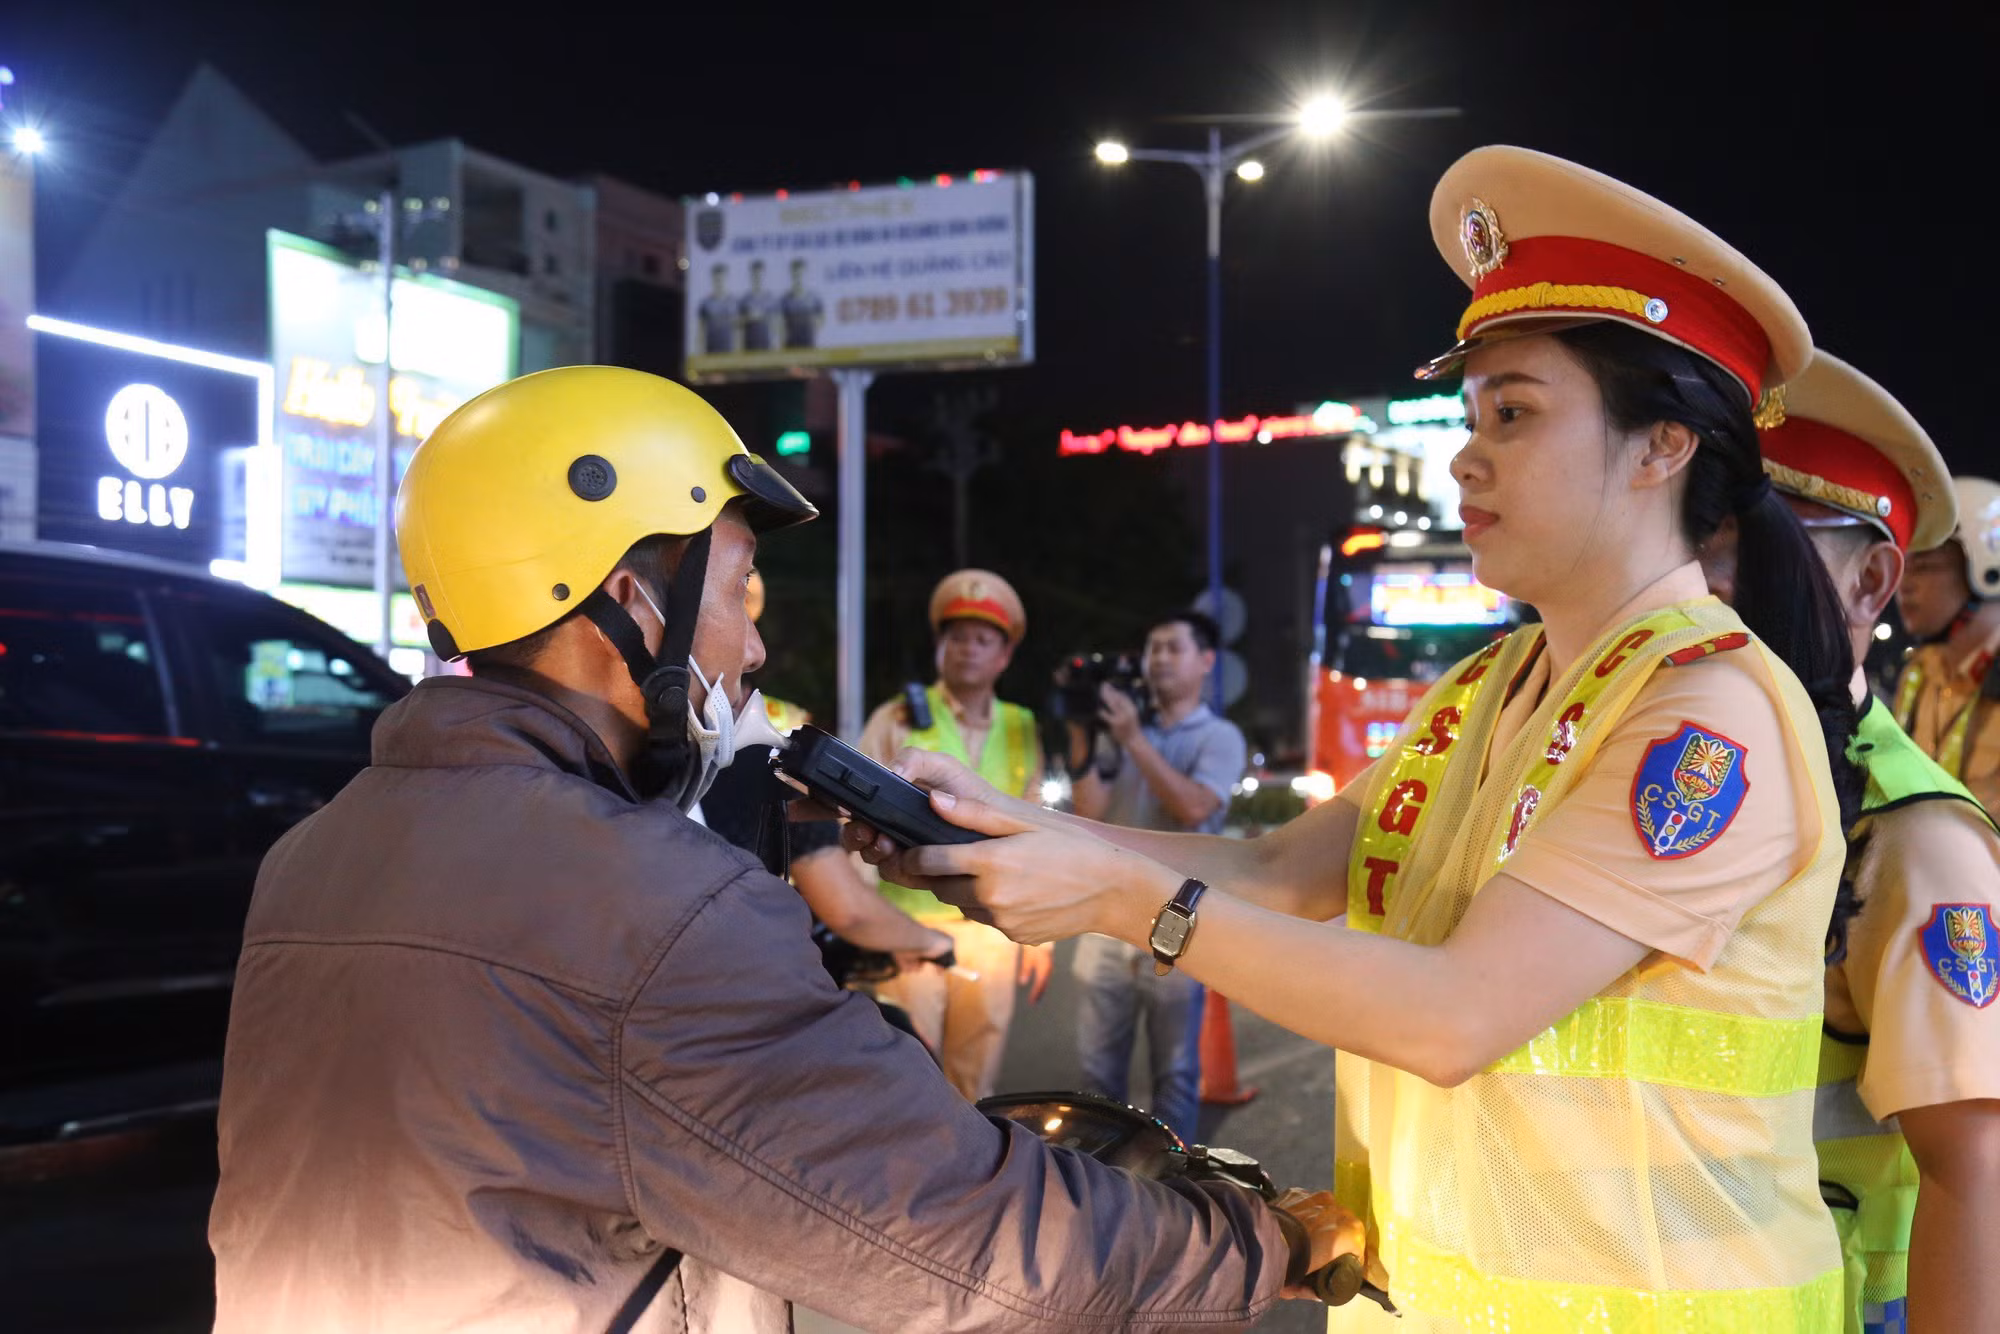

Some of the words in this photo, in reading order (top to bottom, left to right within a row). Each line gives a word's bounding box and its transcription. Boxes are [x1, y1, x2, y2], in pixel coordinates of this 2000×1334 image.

[98, 476, 194, 529] ELLY
[1684, 774, 1709, 791] CAND
[1644, 783, 1721, 829] CSGT
[1938, 957, 1996, 973] CSGT
